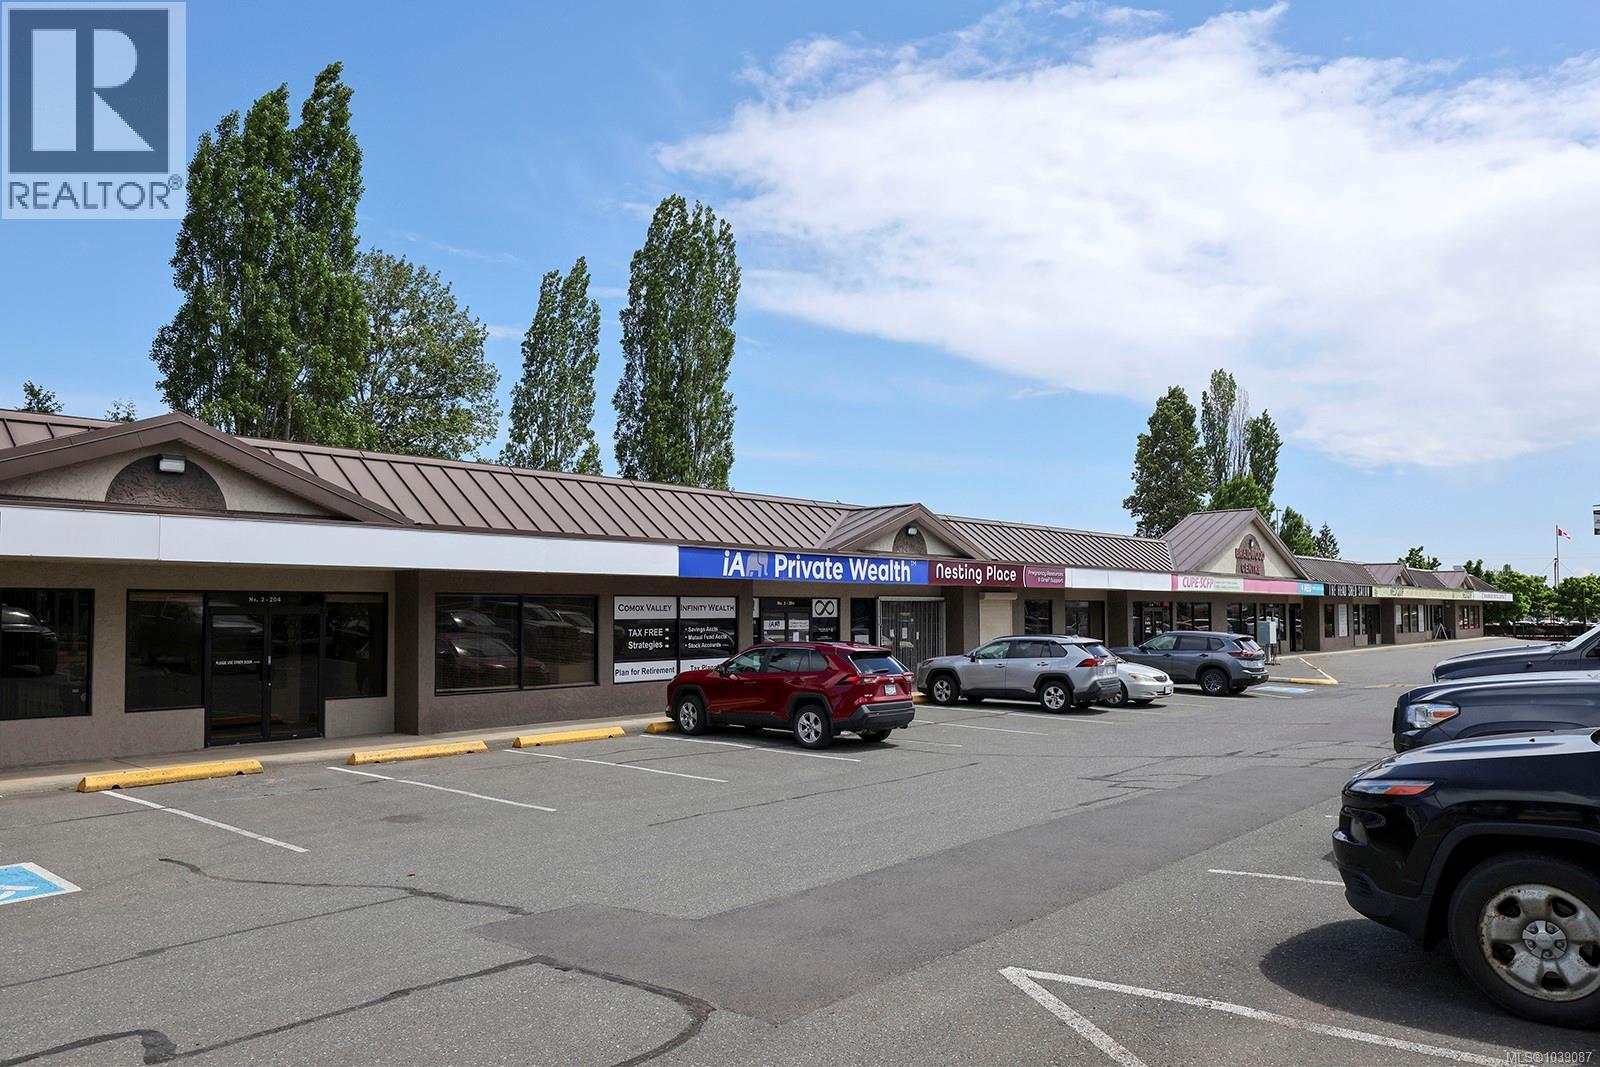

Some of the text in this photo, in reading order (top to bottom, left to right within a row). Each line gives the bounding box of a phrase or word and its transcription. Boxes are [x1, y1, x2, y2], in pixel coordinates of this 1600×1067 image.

[722, 550, 746, 577] iA
[774, 554, 844, 580] Private
[986, 565, 1017, 581] Place
[618, 603, 672, 612] COMOX VALLEY
[680, 604, 735, 612] INFINITY WEALTH
[628, 628, 663, 637] TAX FREE
[628, 641, 663, 651] Strategies
[615, 666, 675, 677] Plan for Retirement
